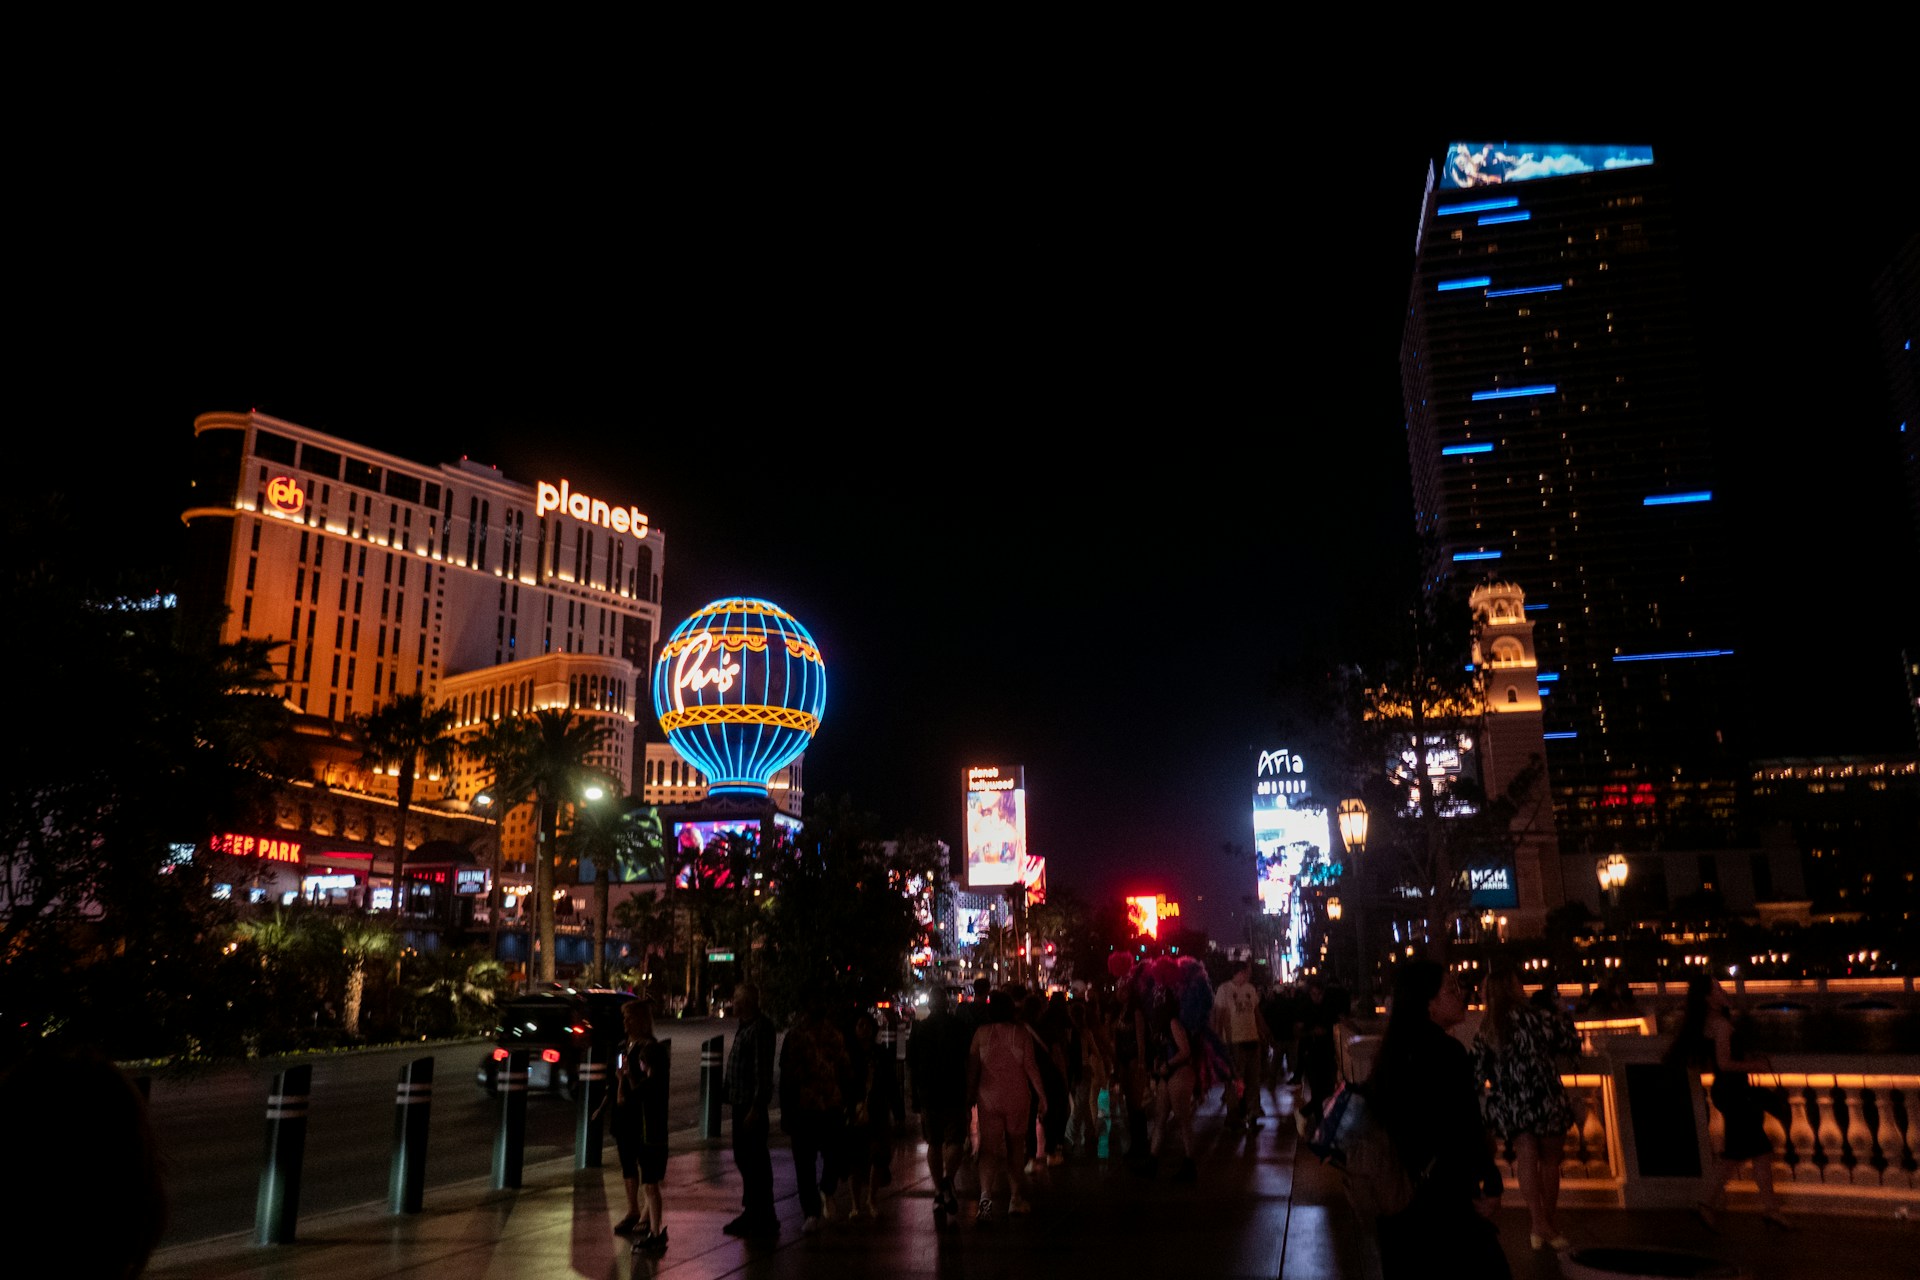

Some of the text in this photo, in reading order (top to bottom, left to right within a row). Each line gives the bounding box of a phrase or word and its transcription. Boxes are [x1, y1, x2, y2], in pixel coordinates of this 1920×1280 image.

[272, 478, 304, 507] ph
[536, 479, 648, 539] planet
[674, 632, 740, 714] Paris
[1257, 749, 1304, 777] Aria
[968, 778, 1014, 792] hollywood
[258, 838, 301, 863] PARK
[1471, 869, 1507, 883] MGM
